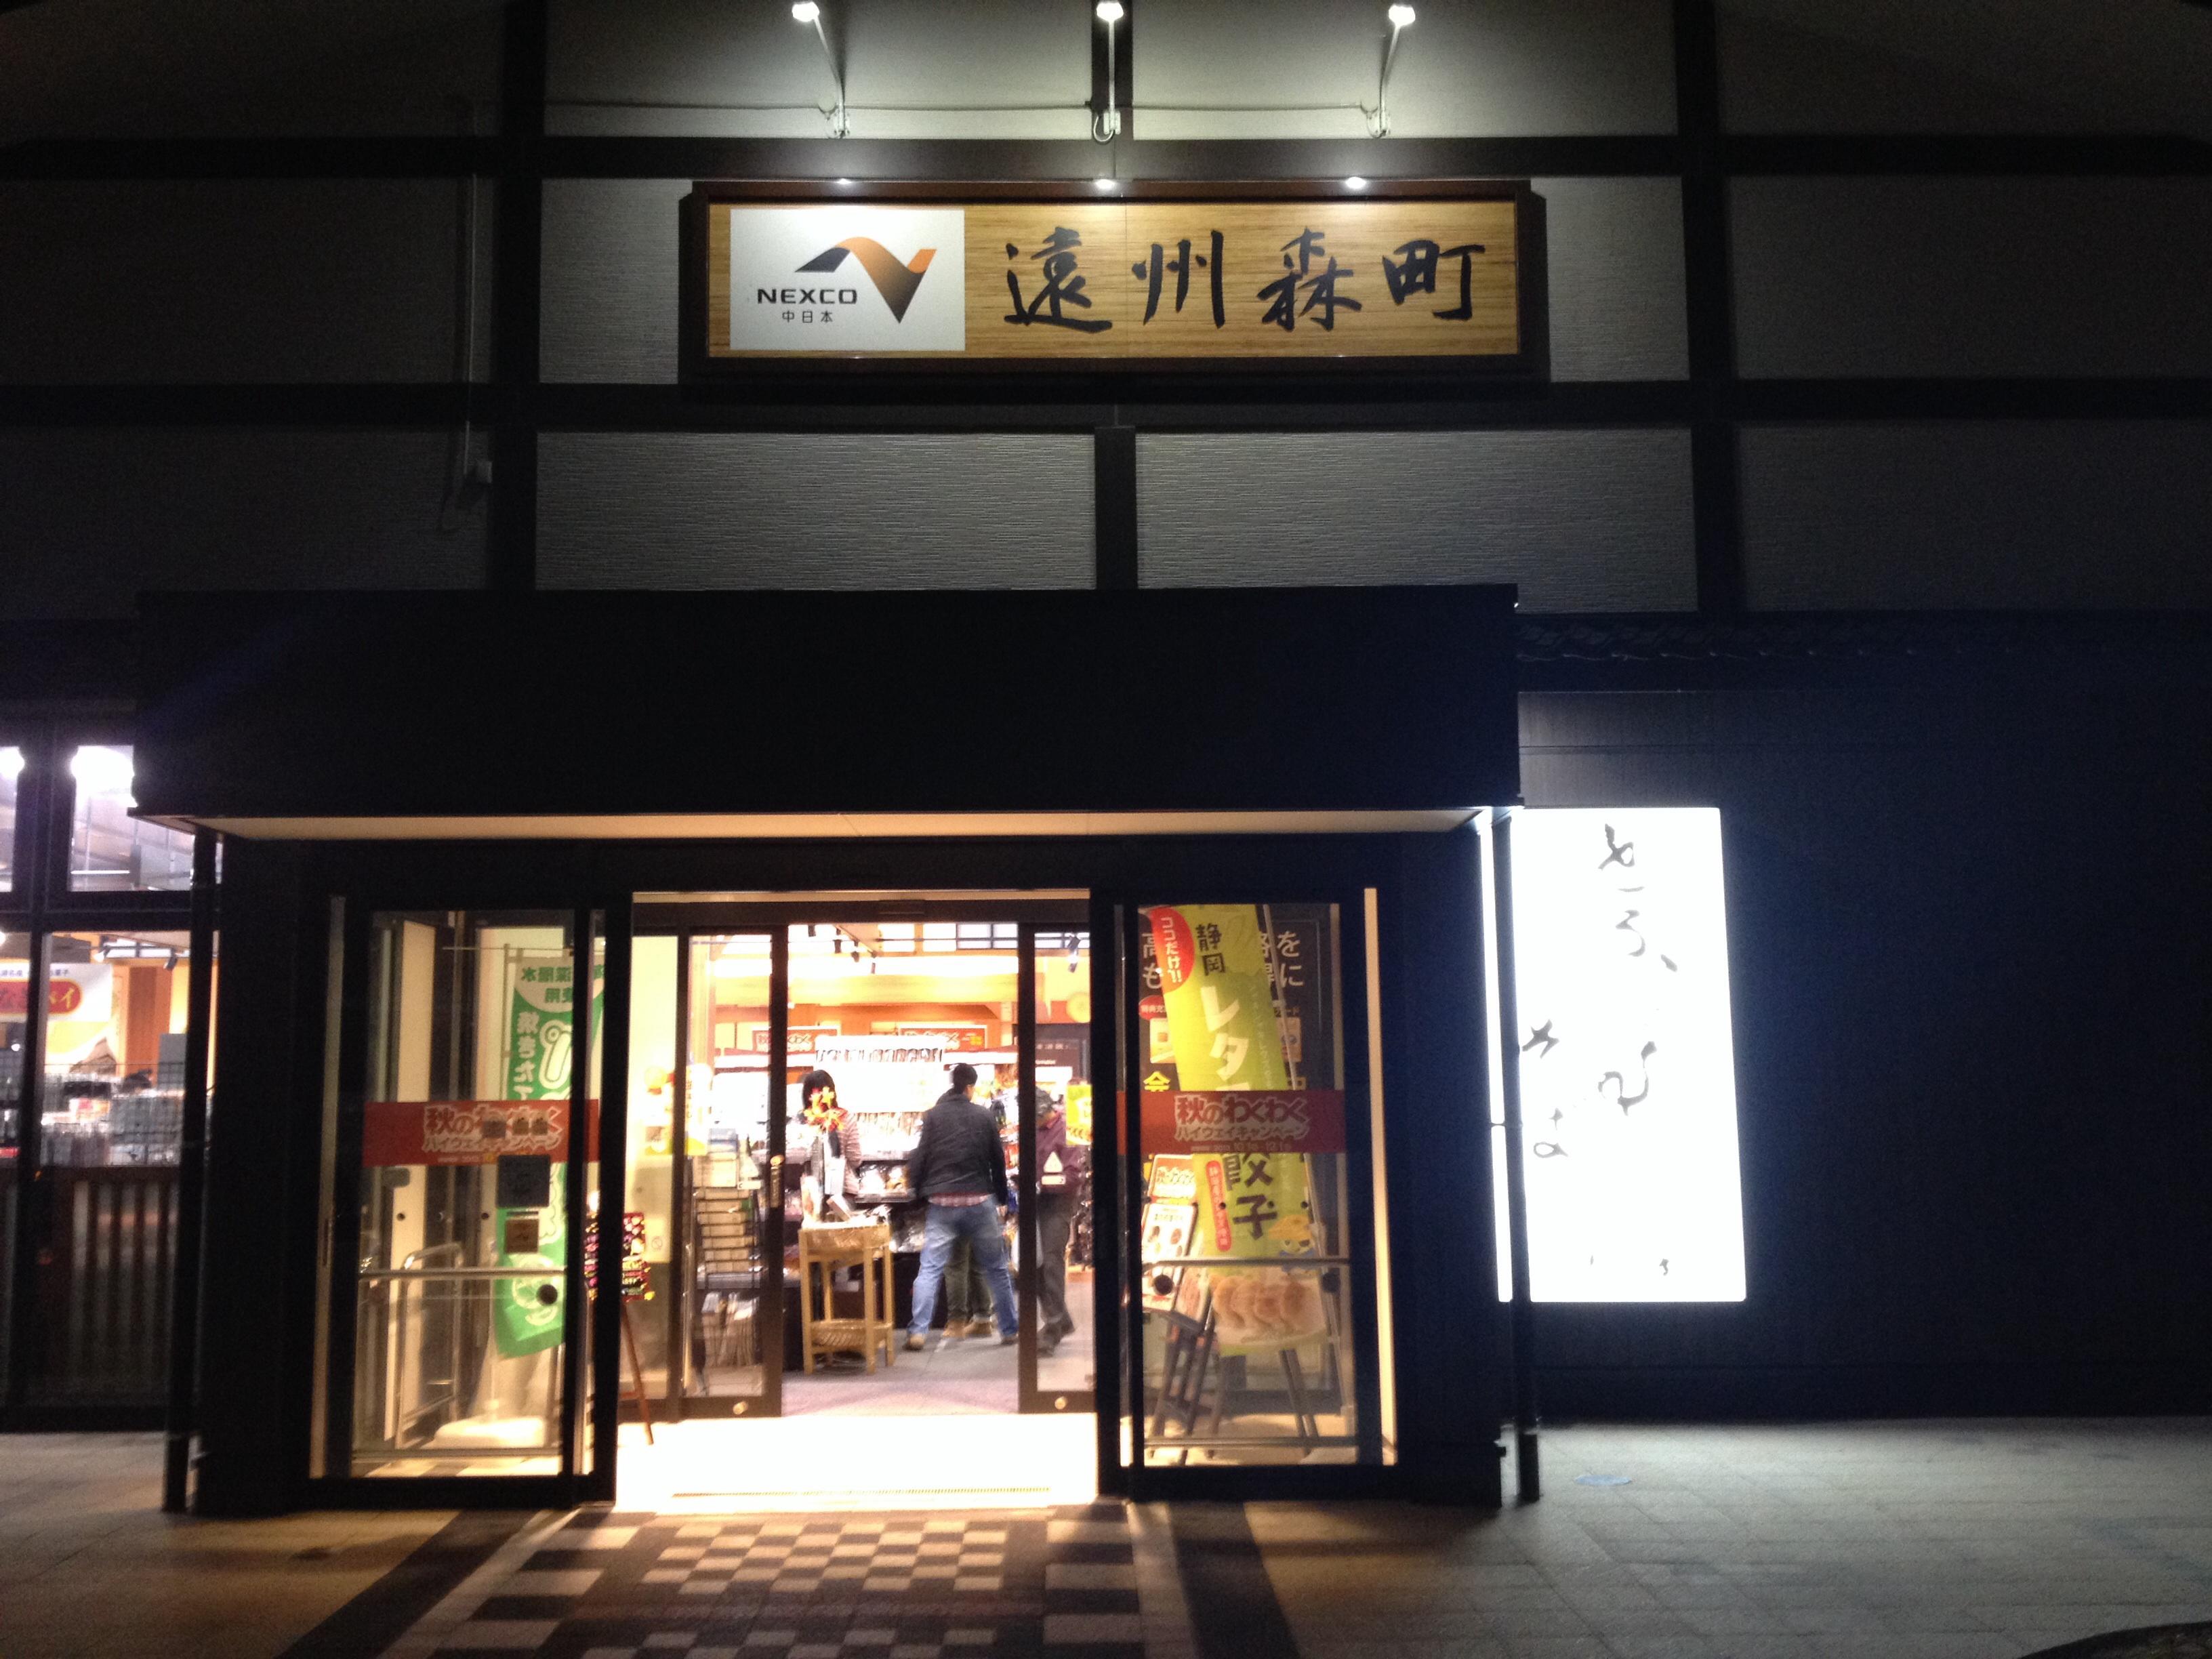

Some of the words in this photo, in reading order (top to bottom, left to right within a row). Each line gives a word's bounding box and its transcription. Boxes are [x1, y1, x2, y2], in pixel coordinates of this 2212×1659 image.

[1003, 226, 1485, 333] 遠州森町
[757, 288, 858, 304] NEXCO
[781, 309, 834, 324] 中日本
[1195, 922, 1226, 977] 静岡
[1176, 1095, 1307, 1126] 秋のわくわく
